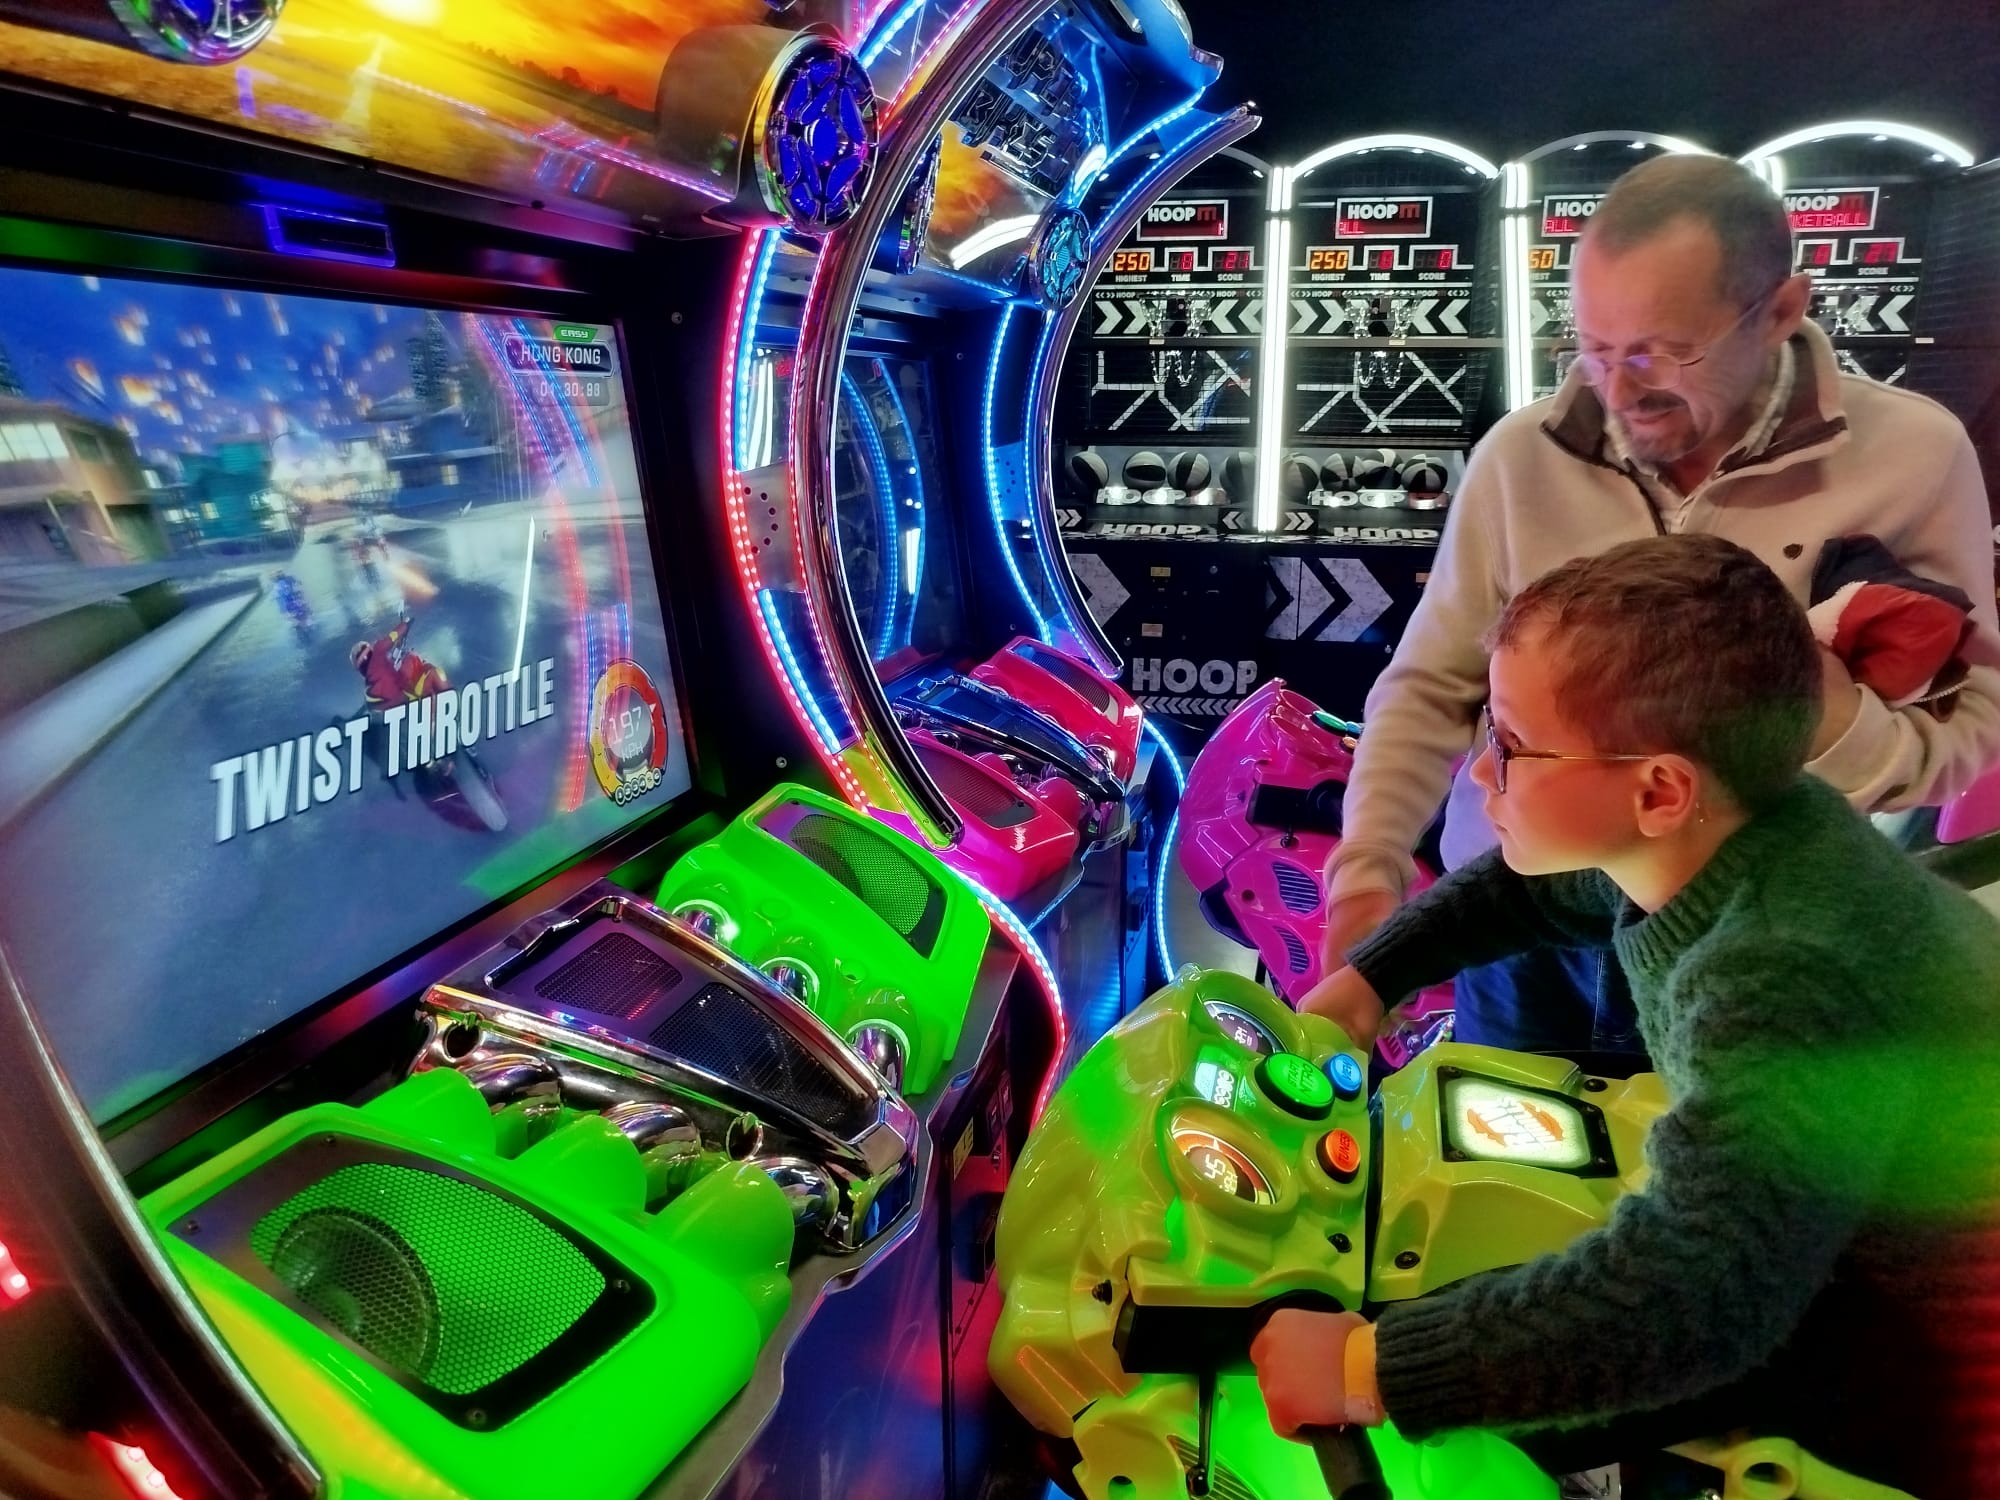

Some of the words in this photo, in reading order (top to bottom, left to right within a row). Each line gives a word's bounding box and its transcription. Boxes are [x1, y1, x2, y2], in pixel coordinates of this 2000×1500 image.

[1147, 207, 1196, 222] HOOP
[1348, 204, 1398, 219] HOOP
[1555, 201, 1603, 217] HOO
[1114, 253, 1150, 271] 250
[1310, 252, 1348, 270] 250
[1115, 274, 1148, 283] HIGHEST
[1170, 273, 1191, 282] TIME
[1217, 273, 1243, 282] SCORE
[1311, 273, 1346, 281] HIGHEST
[1369, 273, 1391, 281] TIME
[1418, 273, 1446, 281] SCORE
[561, 329, 588, 338] EASY
[521, 344, 561, 363] HONG
[565, 347, 601, 364] KONG
[1310, 490, 1406, 508] HOOP
[1132, 657, 1258, 694] HOOP
[609, 705, 642, 744] 197
[210, 716, 370, 843] TWIST
[384, 657, 554, 777] THROTTLE
[621, 741, 644, 762] KPH
[1287, 1059, 1300, 1087] START
[1341, 1055, 1353, 1081] VIEW
[1338, 1133, 1352, 1164] TUNES
